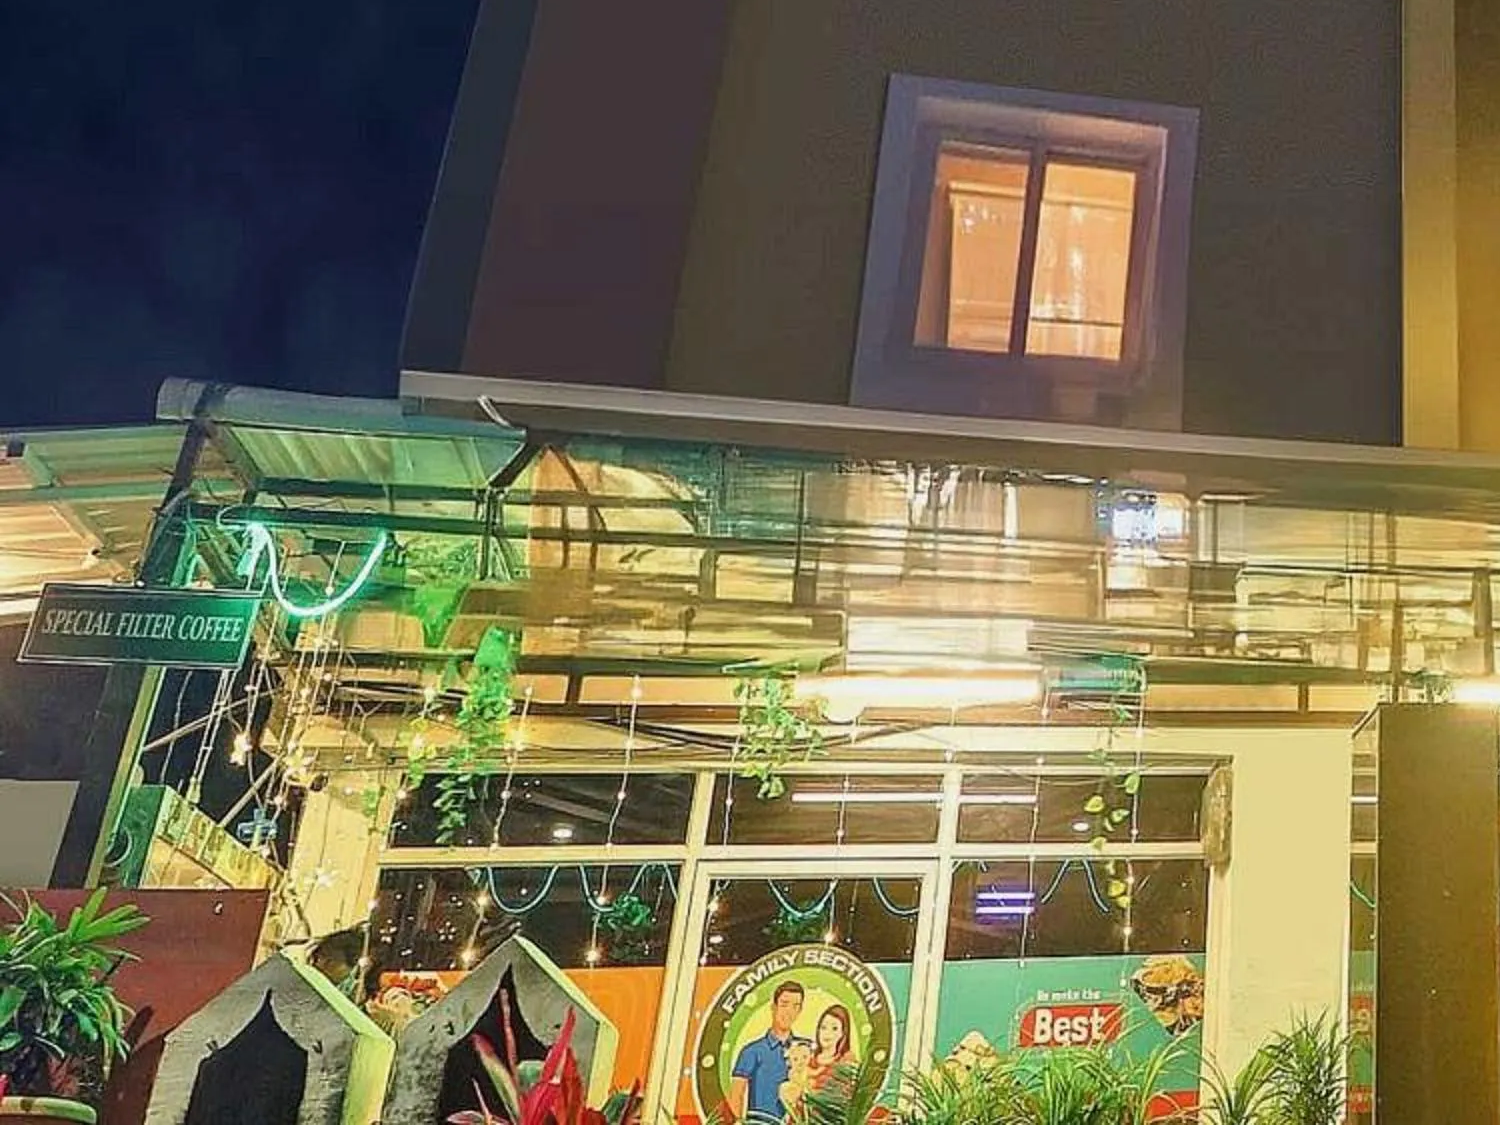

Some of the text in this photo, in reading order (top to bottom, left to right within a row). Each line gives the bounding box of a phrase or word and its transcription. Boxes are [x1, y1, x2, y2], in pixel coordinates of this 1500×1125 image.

[42, 609, 244, 642] SPECIAL FILTER COFFEE
[722, 949, 882, 1014] FAMILY SECTION
[1033, 1006, 1105, 1044] Best
